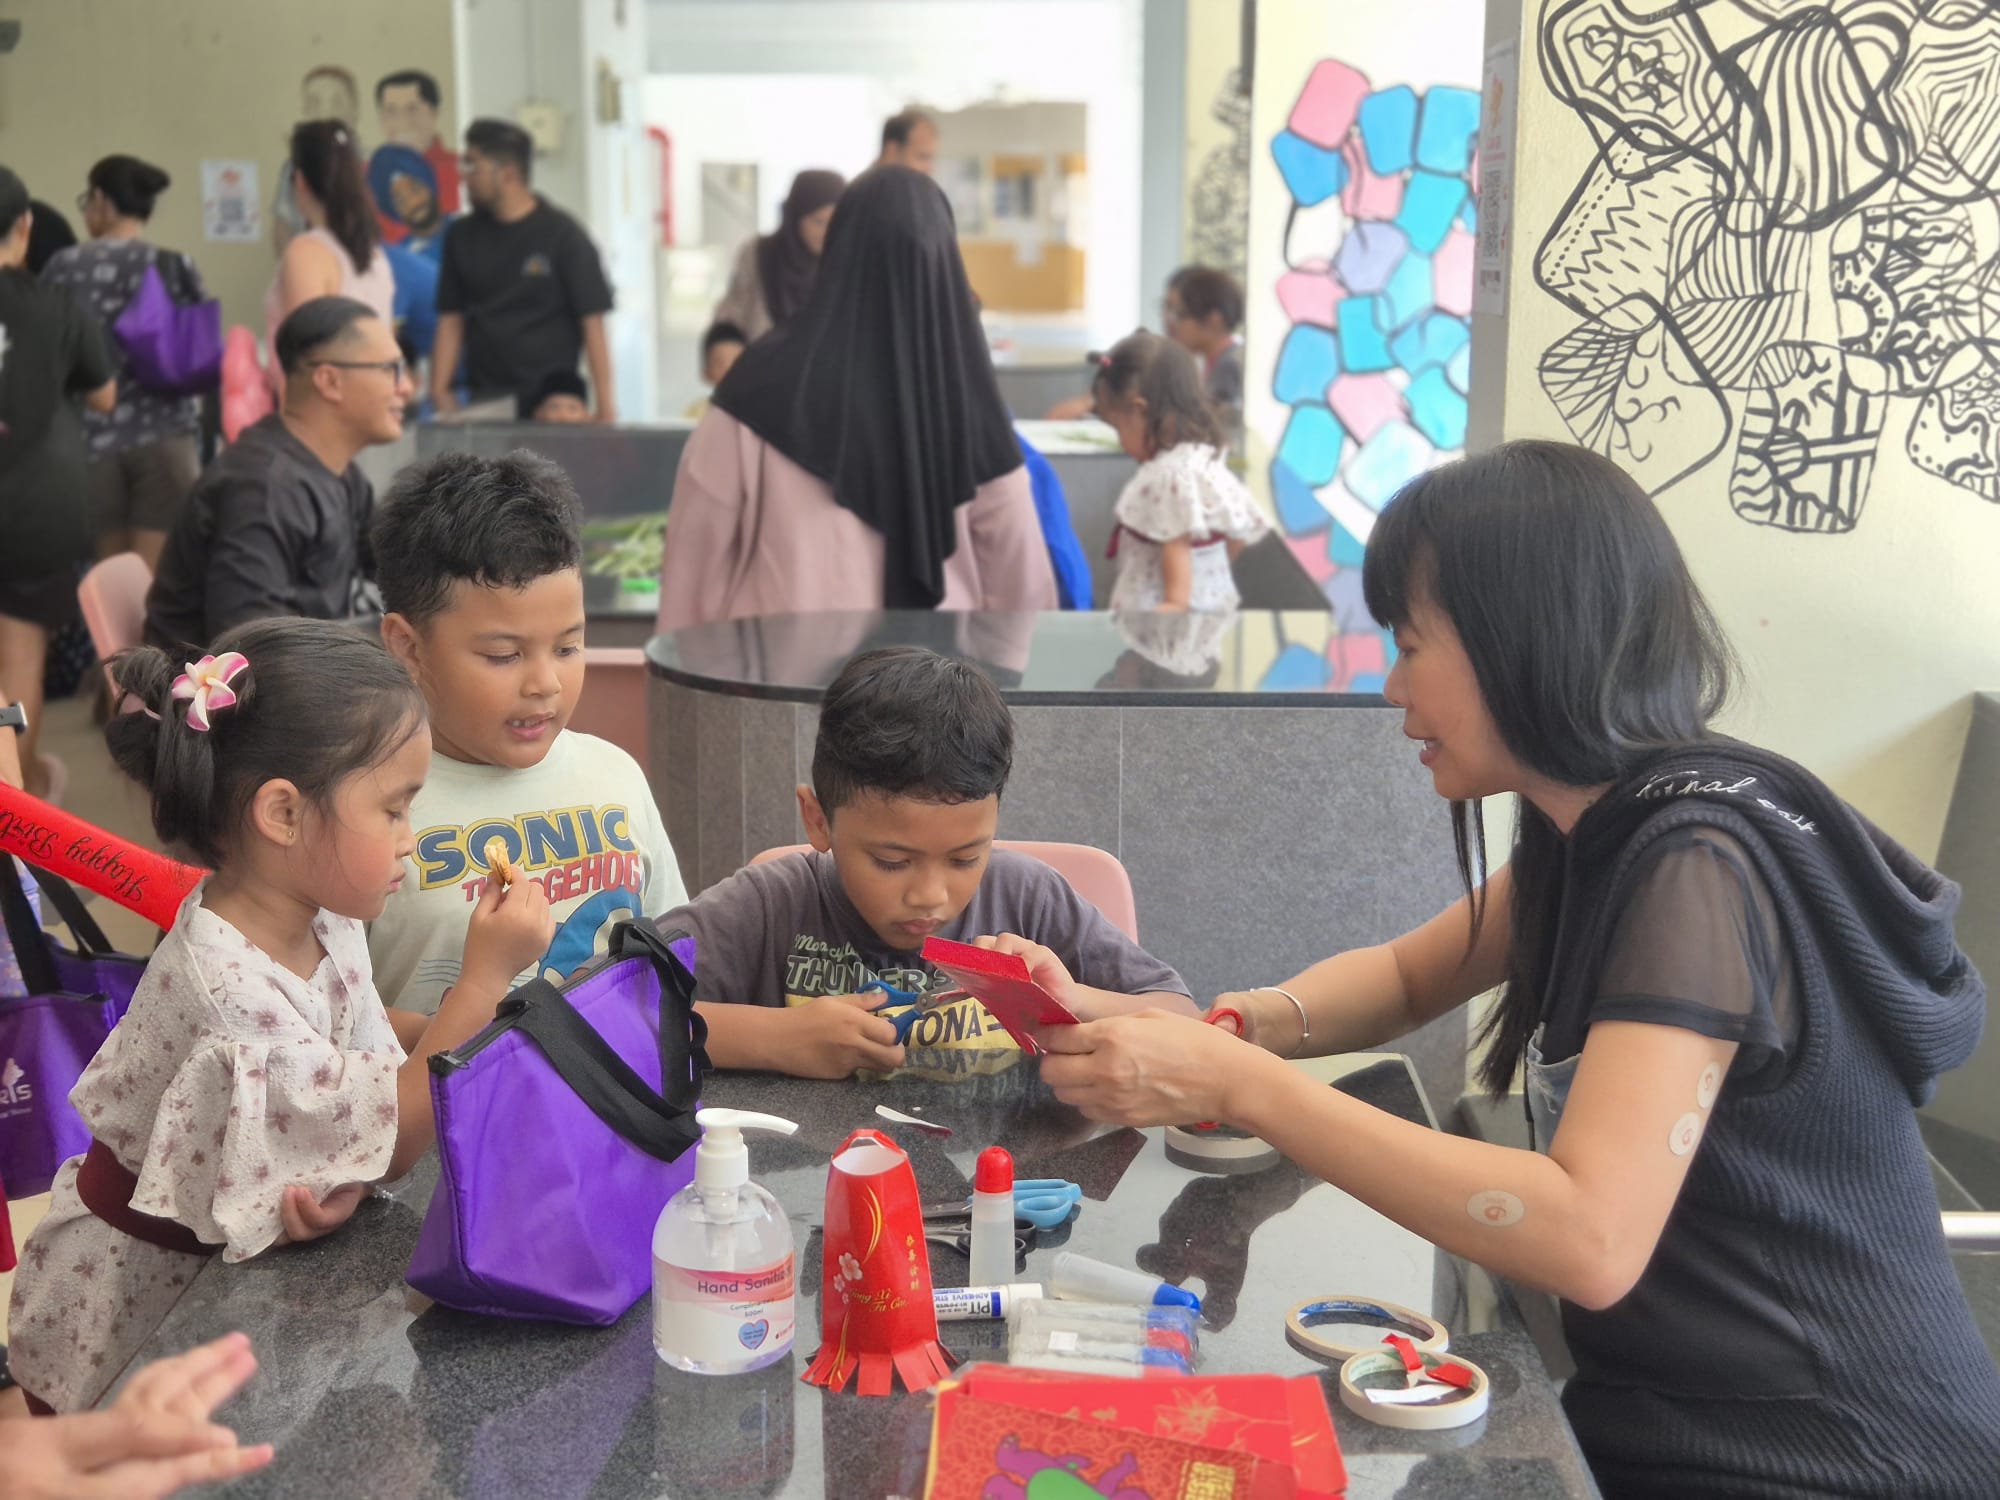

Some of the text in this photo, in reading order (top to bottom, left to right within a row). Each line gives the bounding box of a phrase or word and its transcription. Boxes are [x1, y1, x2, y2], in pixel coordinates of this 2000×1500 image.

[65, 836, 148, 902] Happy
[414, 805, 640, 889] SONIC
[697, 1280, 739, 1294] Hand
